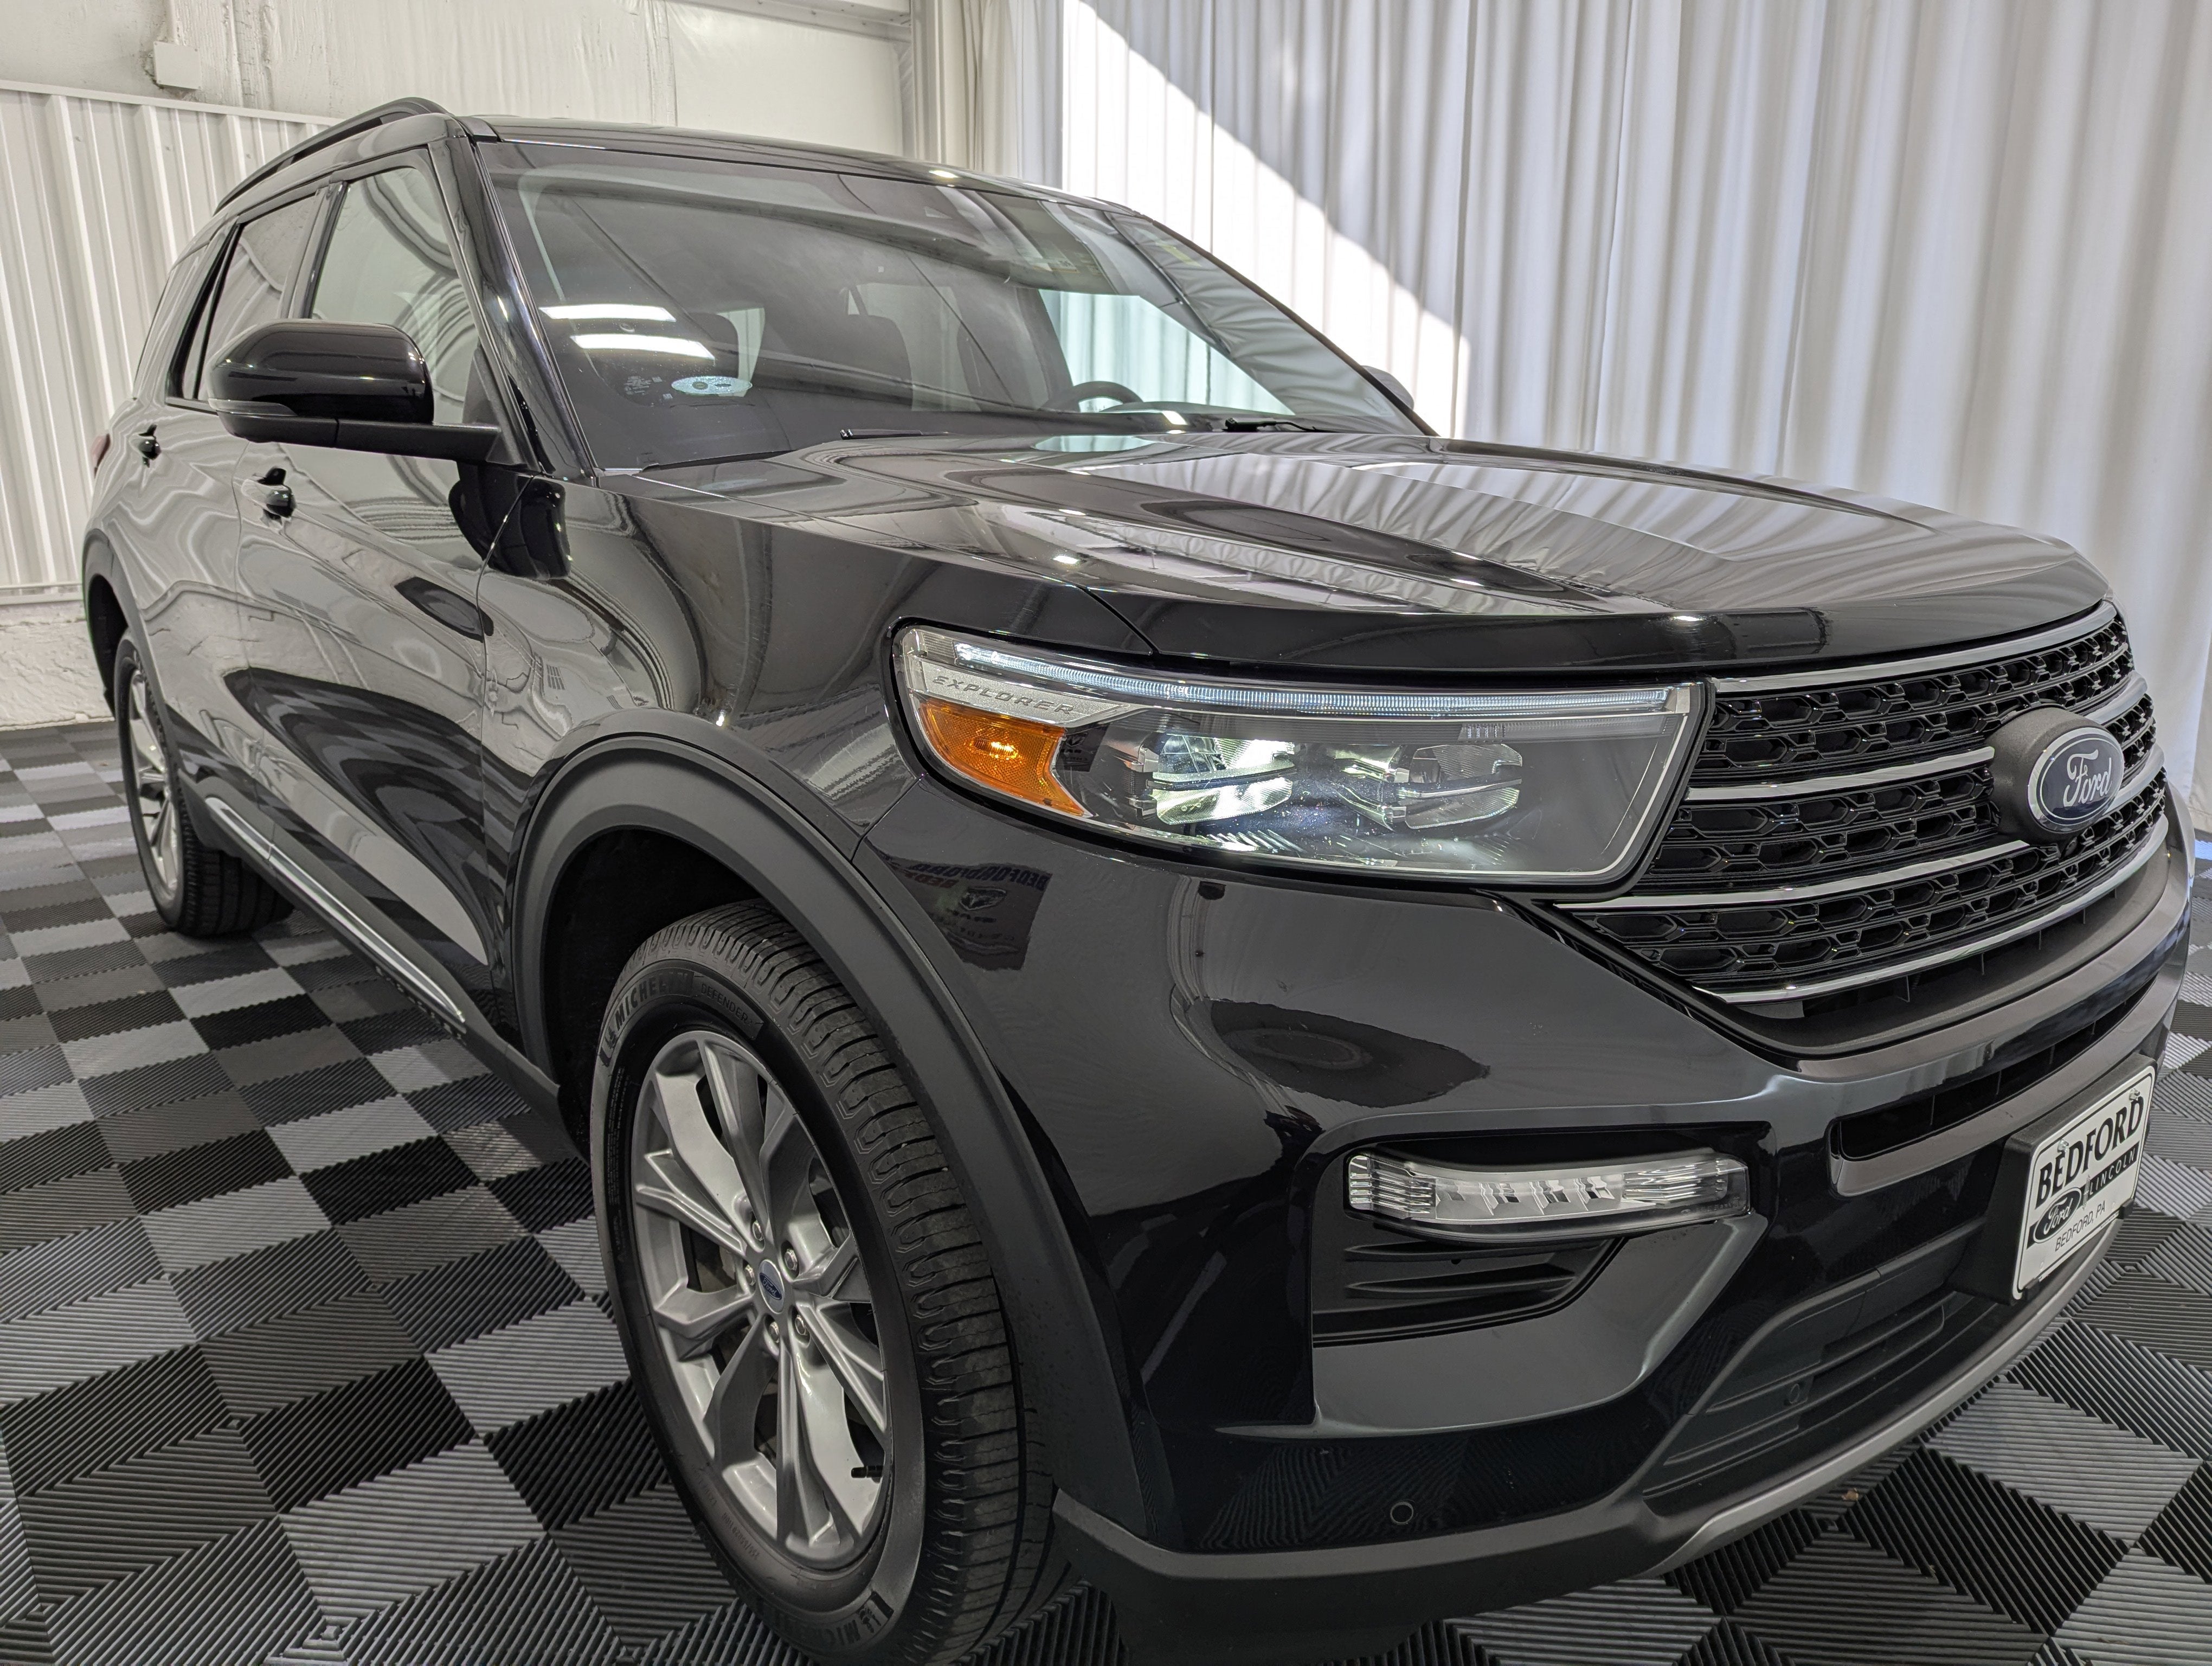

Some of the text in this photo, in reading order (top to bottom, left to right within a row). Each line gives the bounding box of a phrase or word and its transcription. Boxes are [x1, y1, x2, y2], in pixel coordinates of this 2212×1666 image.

[933, 675, 1074, 714] EXPLORER
[2063, 749, 2113, 807] Ford
[2035, 1096, 2143, 1209] BEDFORD
[2043, 1196, 2074, 1235] Ford
[2089, 1147, 2136, 1195] LINCOLN
[2055, 1210, 2094, 1252] BEDFORD,
[2095, 1200, 2106, 1219] PA
